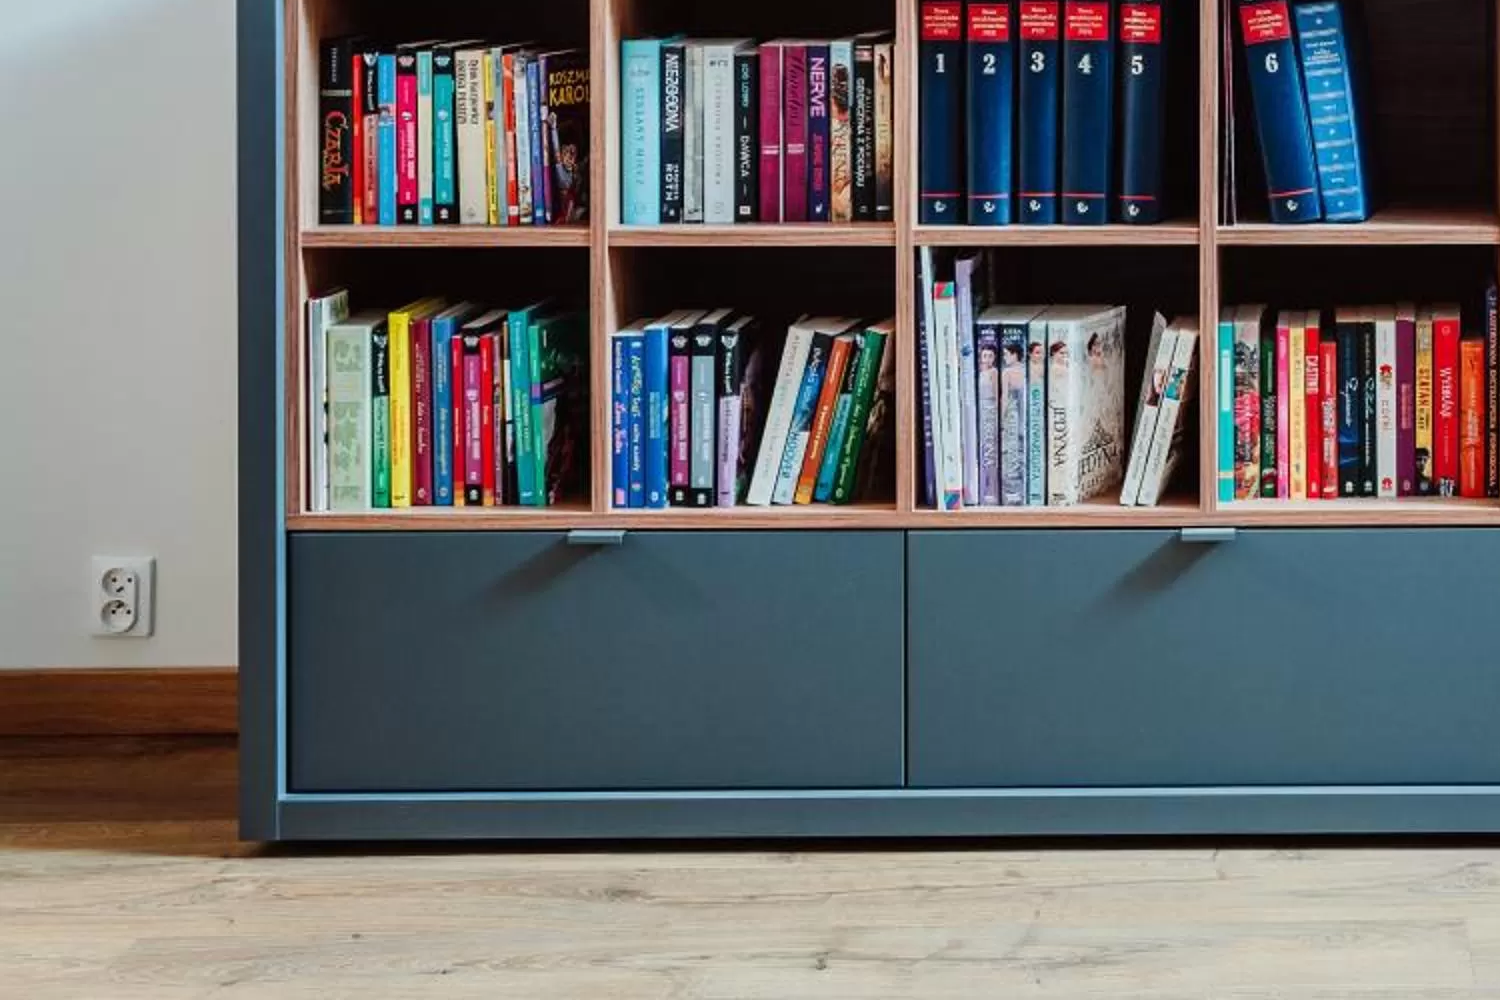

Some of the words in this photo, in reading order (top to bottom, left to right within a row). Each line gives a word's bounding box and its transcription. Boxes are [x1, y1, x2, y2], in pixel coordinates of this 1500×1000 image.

[935, 54, 945, 73] 1
[983, 53, 996, 74] 2
[1031, 52, 1045, 72] 3
[1078, 54, 1092, 74] 4
[1131, 55, 1143, 74] 5
[1265, 53, 1279, 73] 6
[549, 68, 589, 86] KOSZM
[810, 57, 825, 117] NERVE
[1050, 400, 1067, 468] JEDYNA
